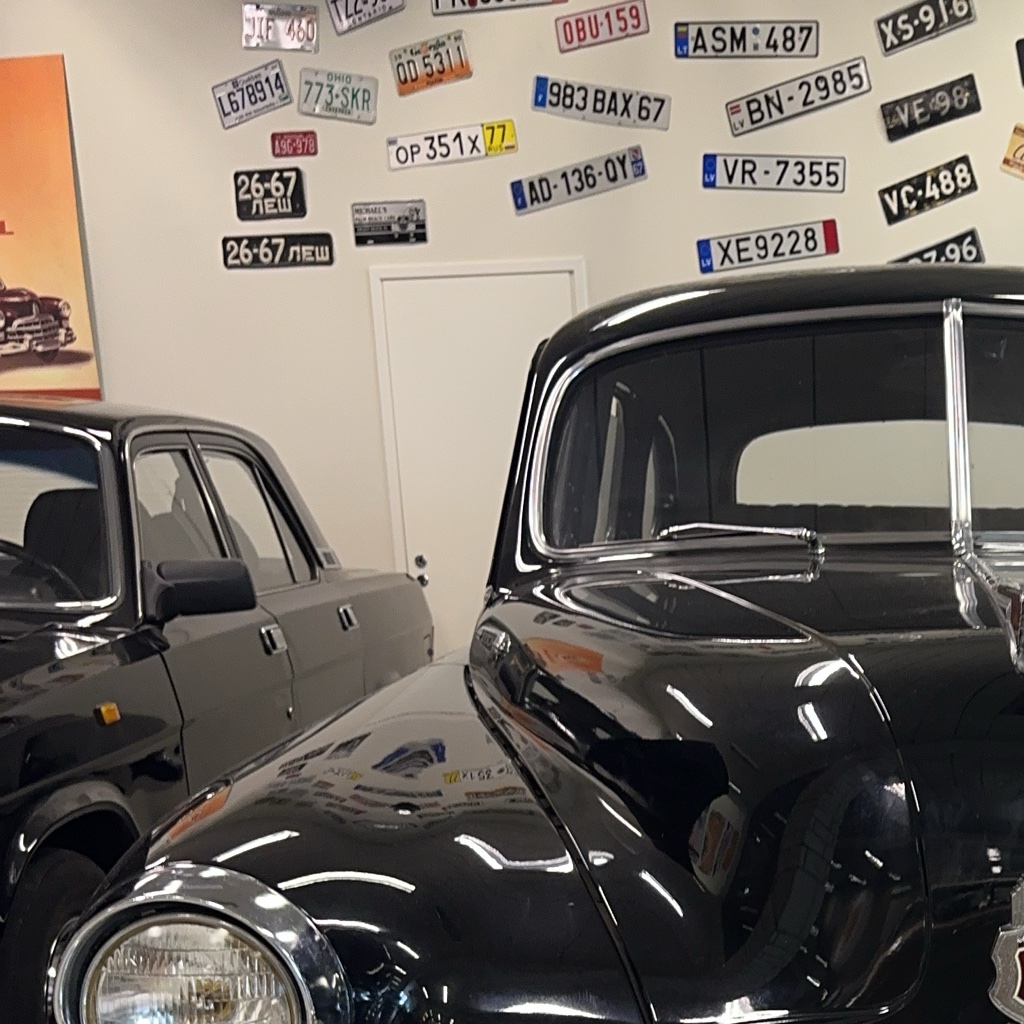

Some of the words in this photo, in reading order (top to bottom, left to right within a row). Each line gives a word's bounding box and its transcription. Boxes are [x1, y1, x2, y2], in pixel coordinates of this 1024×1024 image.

[286, 18, 315, 42] 460
[693, 26, 747, 53] ASM
[766, 26, 813, 52] 487
[422, 45, 465, 78] 5311
[327, 72, 352, 84] OHIO
[218, 72, 284, 117] L678914
[549, 82, 588, 111] 983
[592, 88, 633, 118] BAX
[638, 95, 666, 122] 67
[746, 63, 864, 125] BN-2985
[486, 124, 506, 144] 77
[237, 171, 297, 200] 26-67
[704, 173, 716, 182] LV
[701, 258, 711, 268] LV
[717, 227, 818, 266] XE9228
